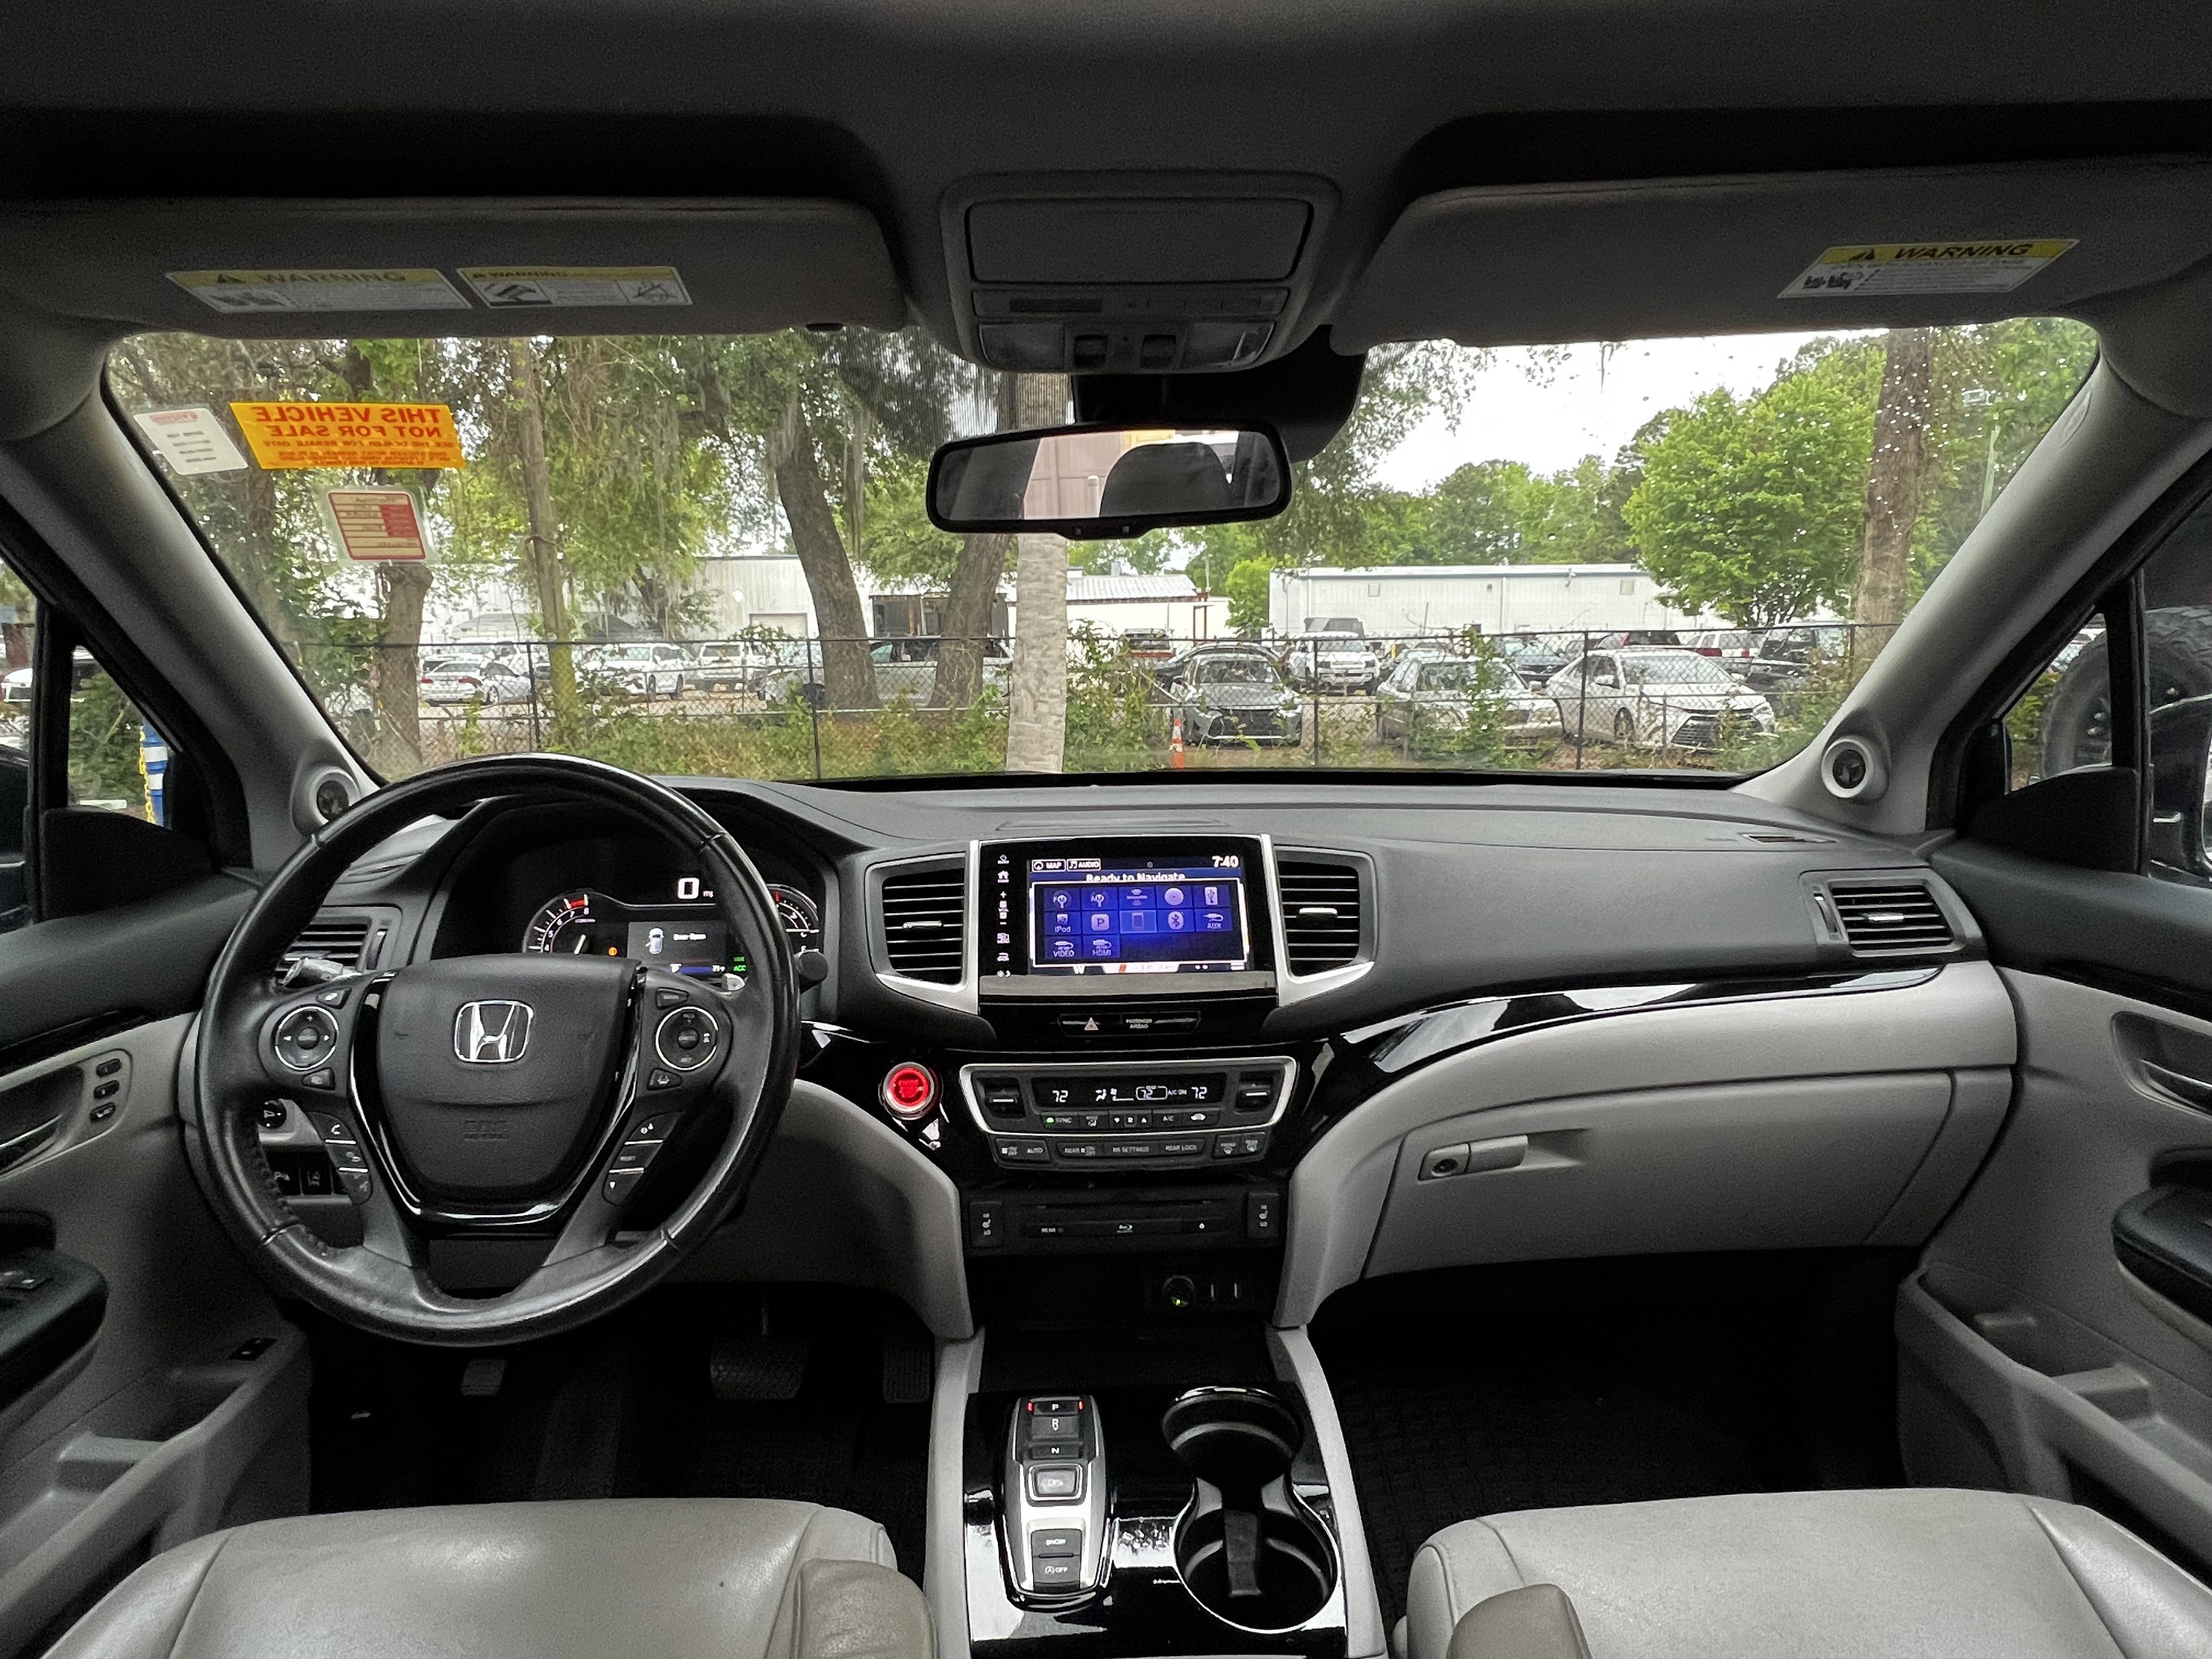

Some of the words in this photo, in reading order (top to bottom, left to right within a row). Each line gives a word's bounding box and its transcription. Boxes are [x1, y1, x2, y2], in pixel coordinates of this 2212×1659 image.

[1895, 243, 2034, 259] WARNING
[262, 272, 407, 284] WARNING
[1211, 855, 1239, 868] 7:40
[1086, 873, 1120, 882] Ready
[1137, 872, 1186, 881] Navigate
[677, 877, 699, 900] 0
[548, 930, 554, 938] 5
[1052, 1090, 1069, 1103] 72
[1141, 1089, 1153, 1098] 72
[1190, 1086, 1208, 1099] 72
